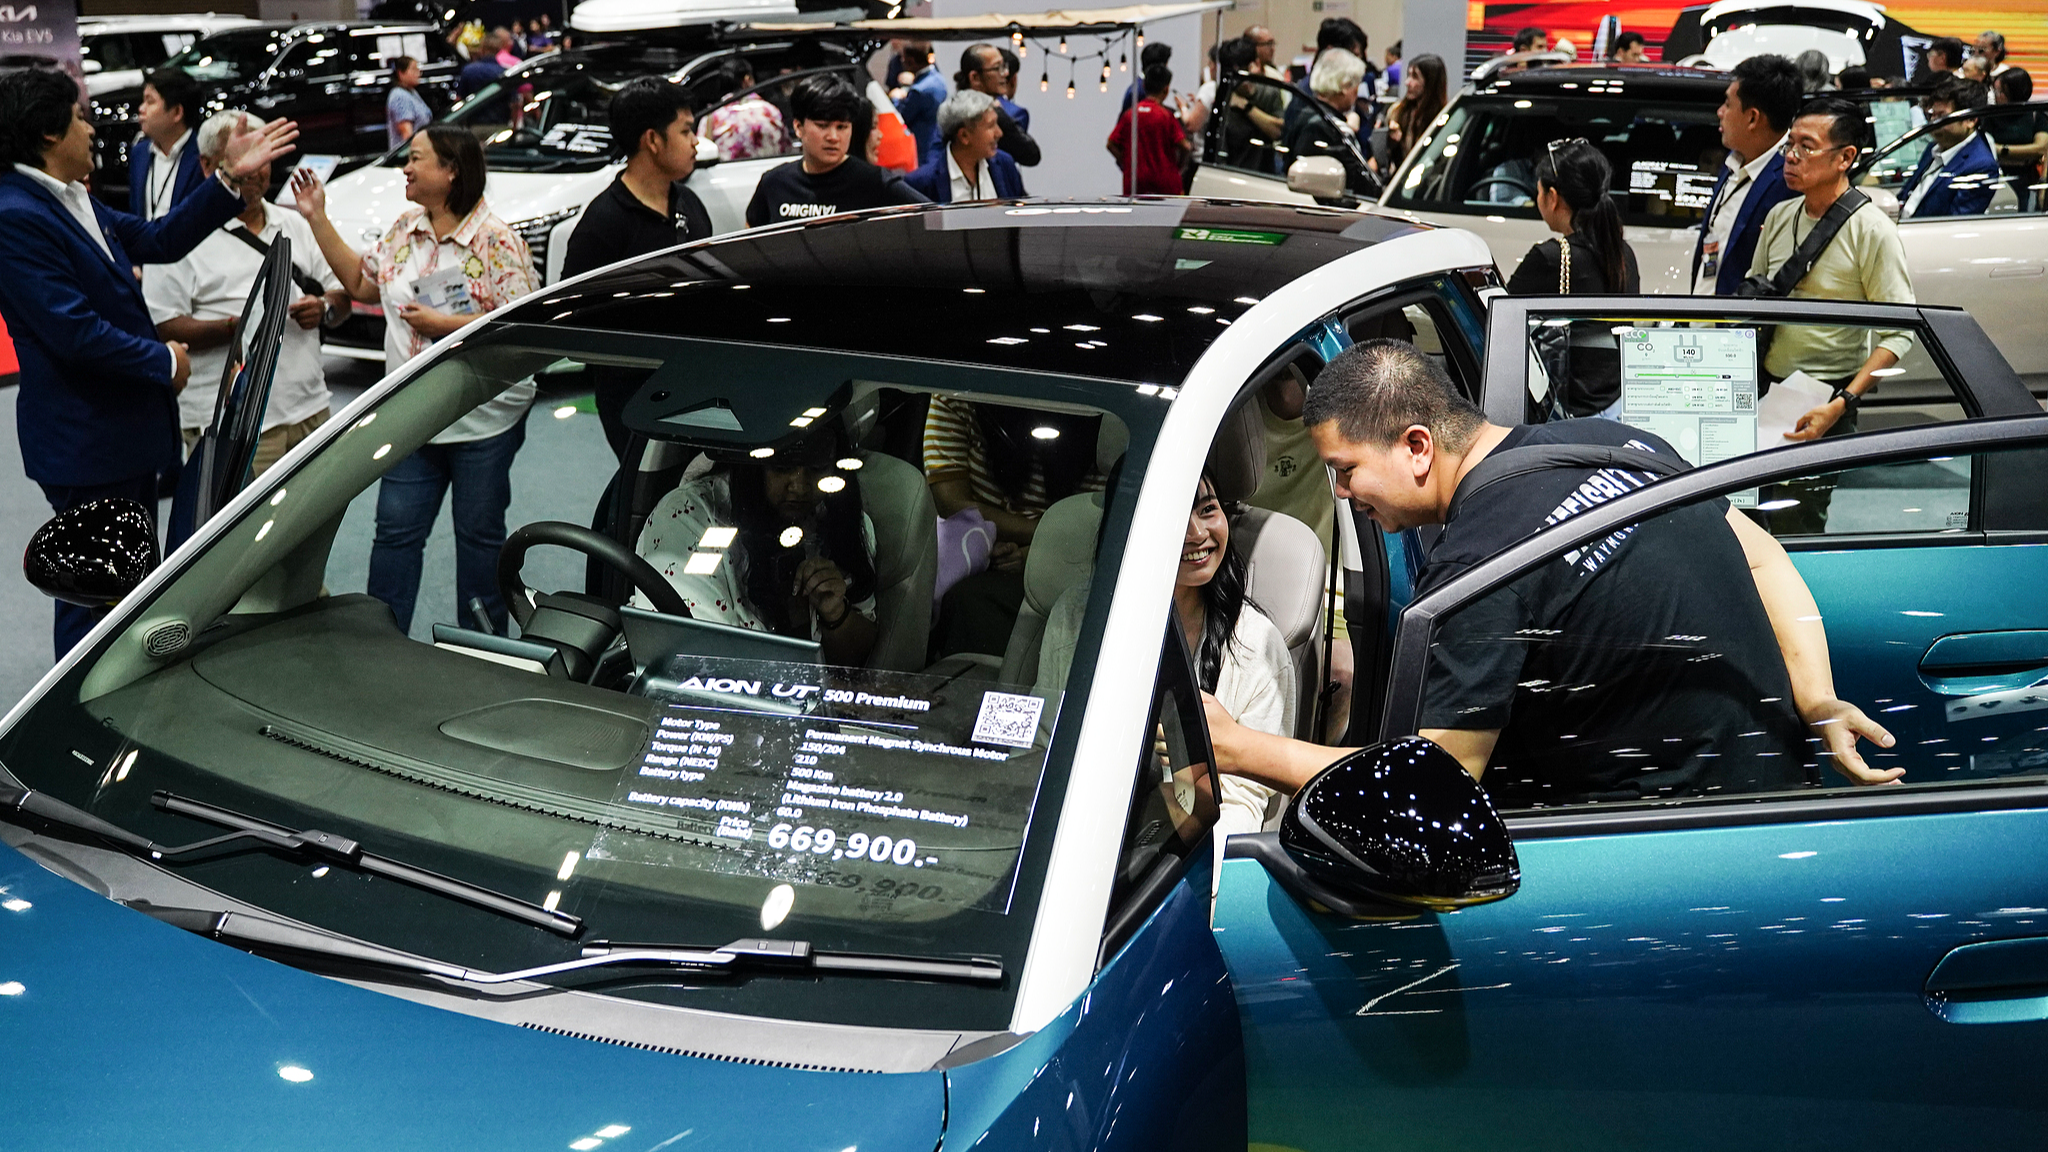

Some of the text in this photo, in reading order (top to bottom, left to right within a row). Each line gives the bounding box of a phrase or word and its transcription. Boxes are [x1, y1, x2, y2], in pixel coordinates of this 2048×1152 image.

[1682, 348, 1696, 356] 140
[676, 676, 931, 712] AION UT 500 Premium
[661, 717, 720, 732] Motor Type
[655, 729, 690, 741] Power
[651, 741, 689, 755] Torque
[799, 741, 847, 756] 150/204
[804, 729, 867, 745] Permanent
[867, 735, 911, 751] Magnet
[910, 740, 973, 757] Synchrous
[972, 747, 1010, 762] Motor
[644, 754, 719, 770] Range (NEDC)
[795, 753, 818, 766] 210
[638, 766, 705, 782] Battery type
[791, 766, 834, 782] 500 Km
[785, 779, 904, 803] Magazine battery 2.0
[627, 791, 751, 814] Battery capacity (KWh)
[776, 806, 803, 819] 60.0
[781, 793, 969, 828] (Lithium Iron Phosphate Battery)
[719, 815, 750, 828] Price
[716, 825, 753, 840] (Baht)
[768, 823, 940, 868] 669,900.-
